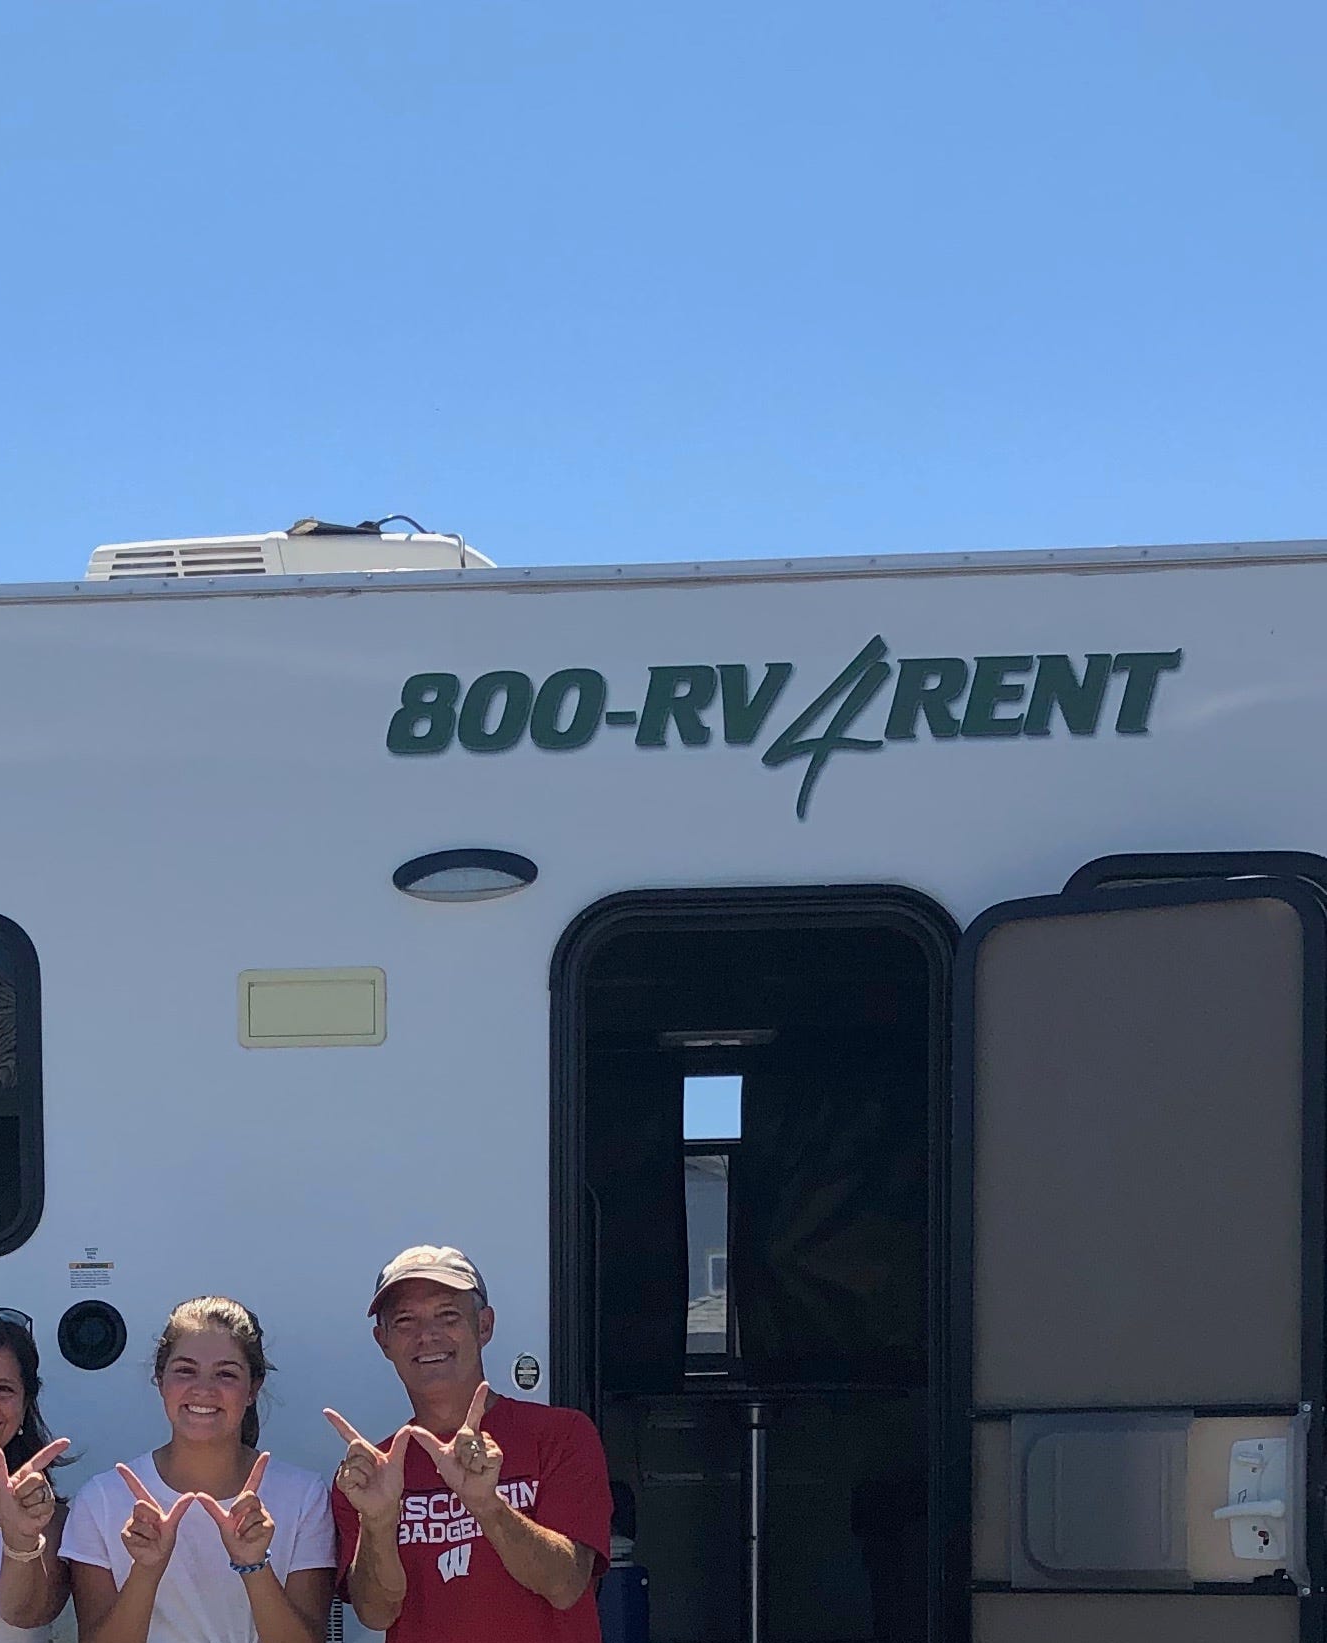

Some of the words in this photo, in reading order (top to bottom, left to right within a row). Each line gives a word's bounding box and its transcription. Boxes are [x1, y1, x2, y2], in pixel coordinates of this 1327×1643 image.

[386, 634, 1183, 819] 800-RV4RENT
[400, 1480, 539, 1521] SCOSIN
[398, 1516, 483, 1545] BADGE
